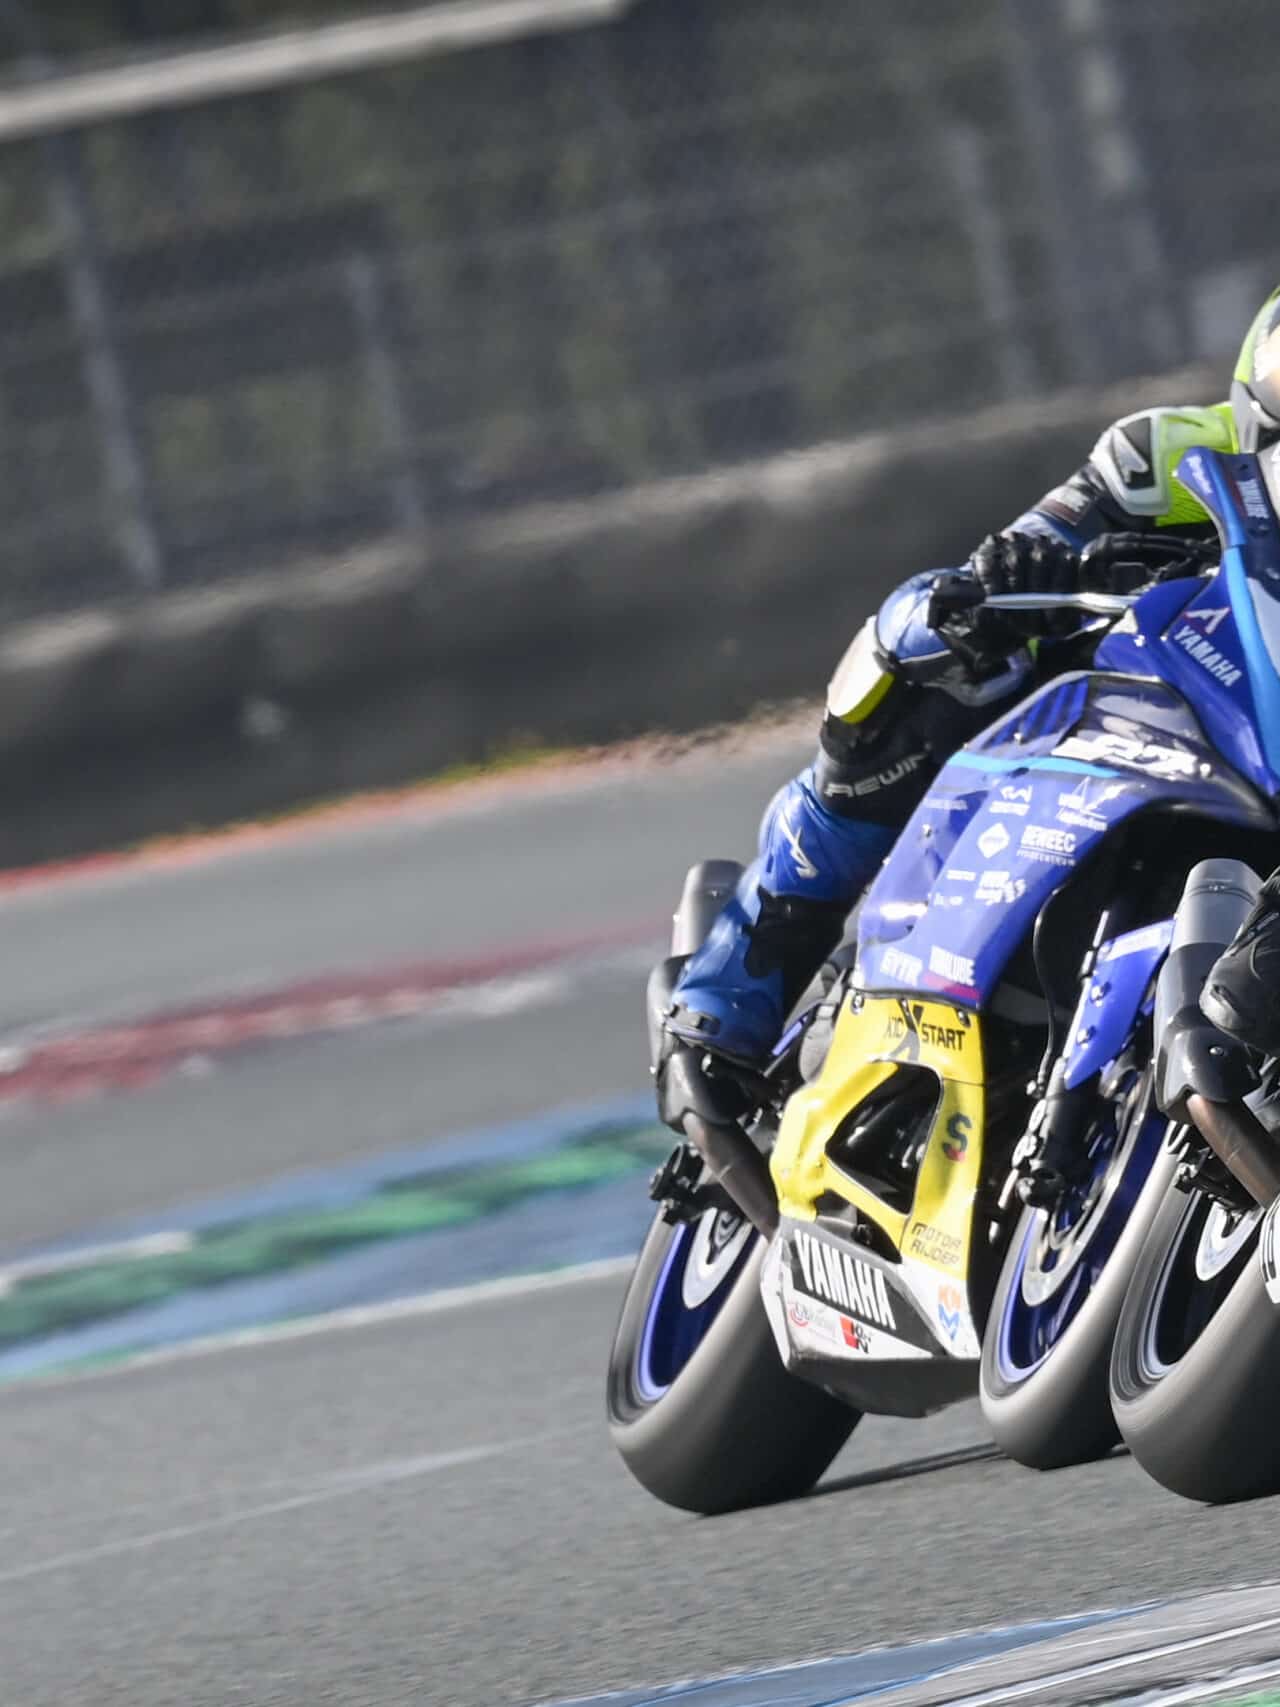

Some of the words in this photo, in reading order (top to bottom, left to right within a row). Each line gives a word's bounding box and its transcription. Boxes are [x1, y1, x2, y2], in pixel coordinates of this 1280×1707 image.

[1173, 624, 1243, 687] YAMAHA
[911, 1222, 962, 1249] MOTOR
[794, 1228, 897, 1331] YAMAHA
